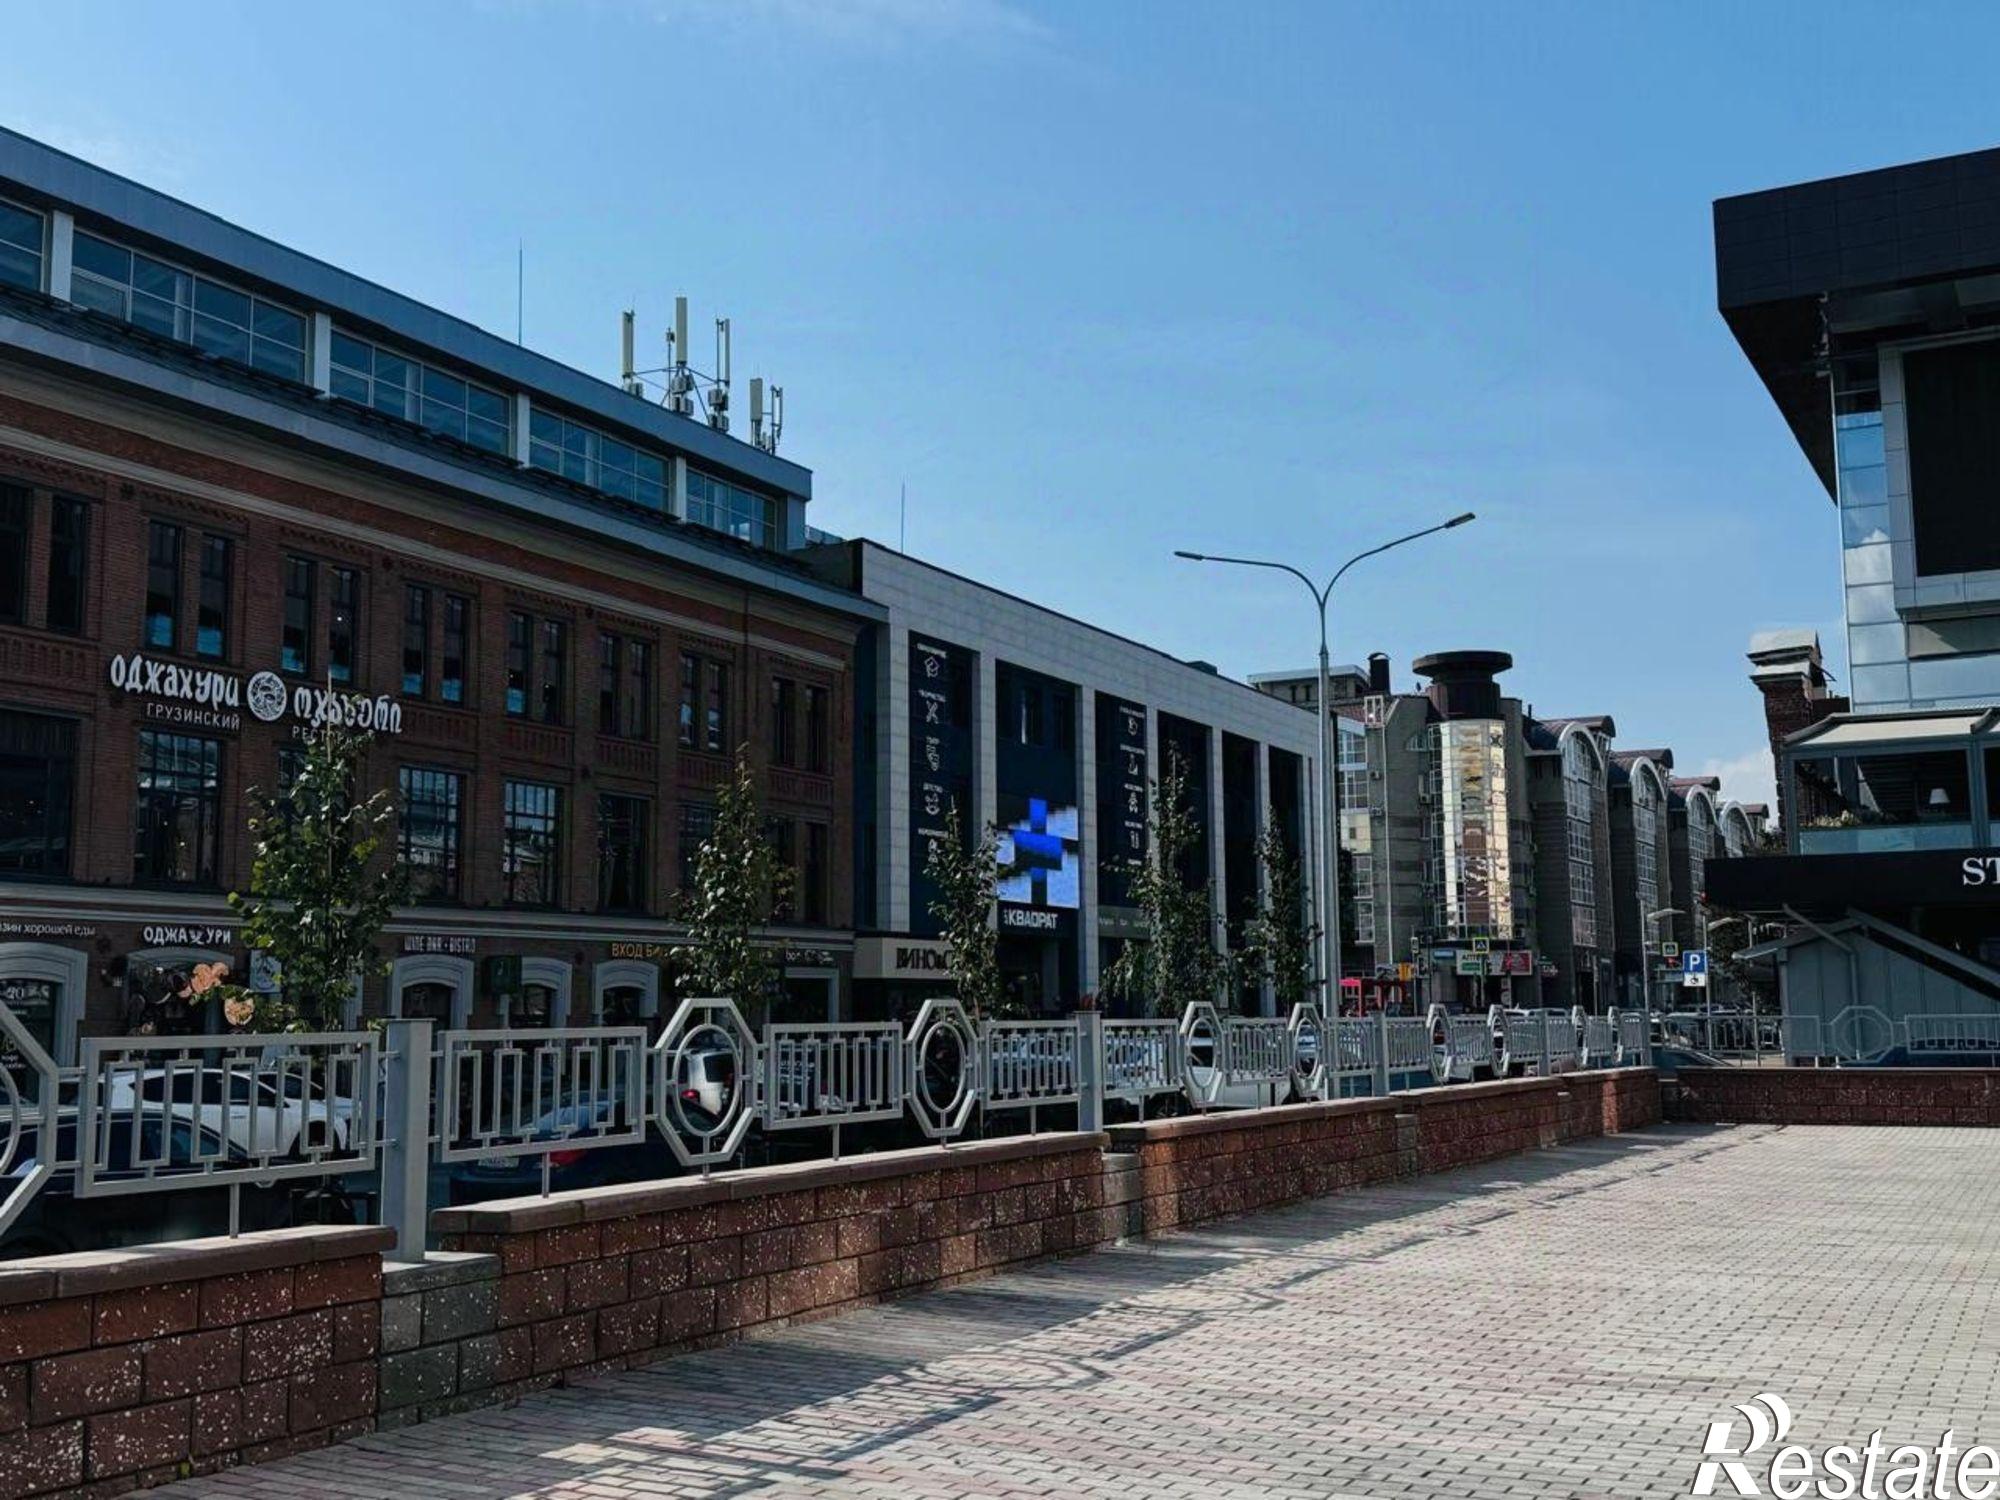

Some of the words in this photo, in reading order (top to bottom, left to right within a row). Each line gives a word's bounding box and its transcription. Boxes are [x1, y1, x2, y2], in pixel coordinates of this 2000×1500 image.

[146, 701, 241, 731] ГРУЗИНСКИЙ
[1007, 909, 1059, 930] КВАДРАТ
[23, 922, 73, 938] хорошей
[74, 925, 96, 939] еды
[449, 937, 476, 953] BISTRO
[611, 943, 644, 959] ВХОД
[1689, 953, 1701, 971] P
